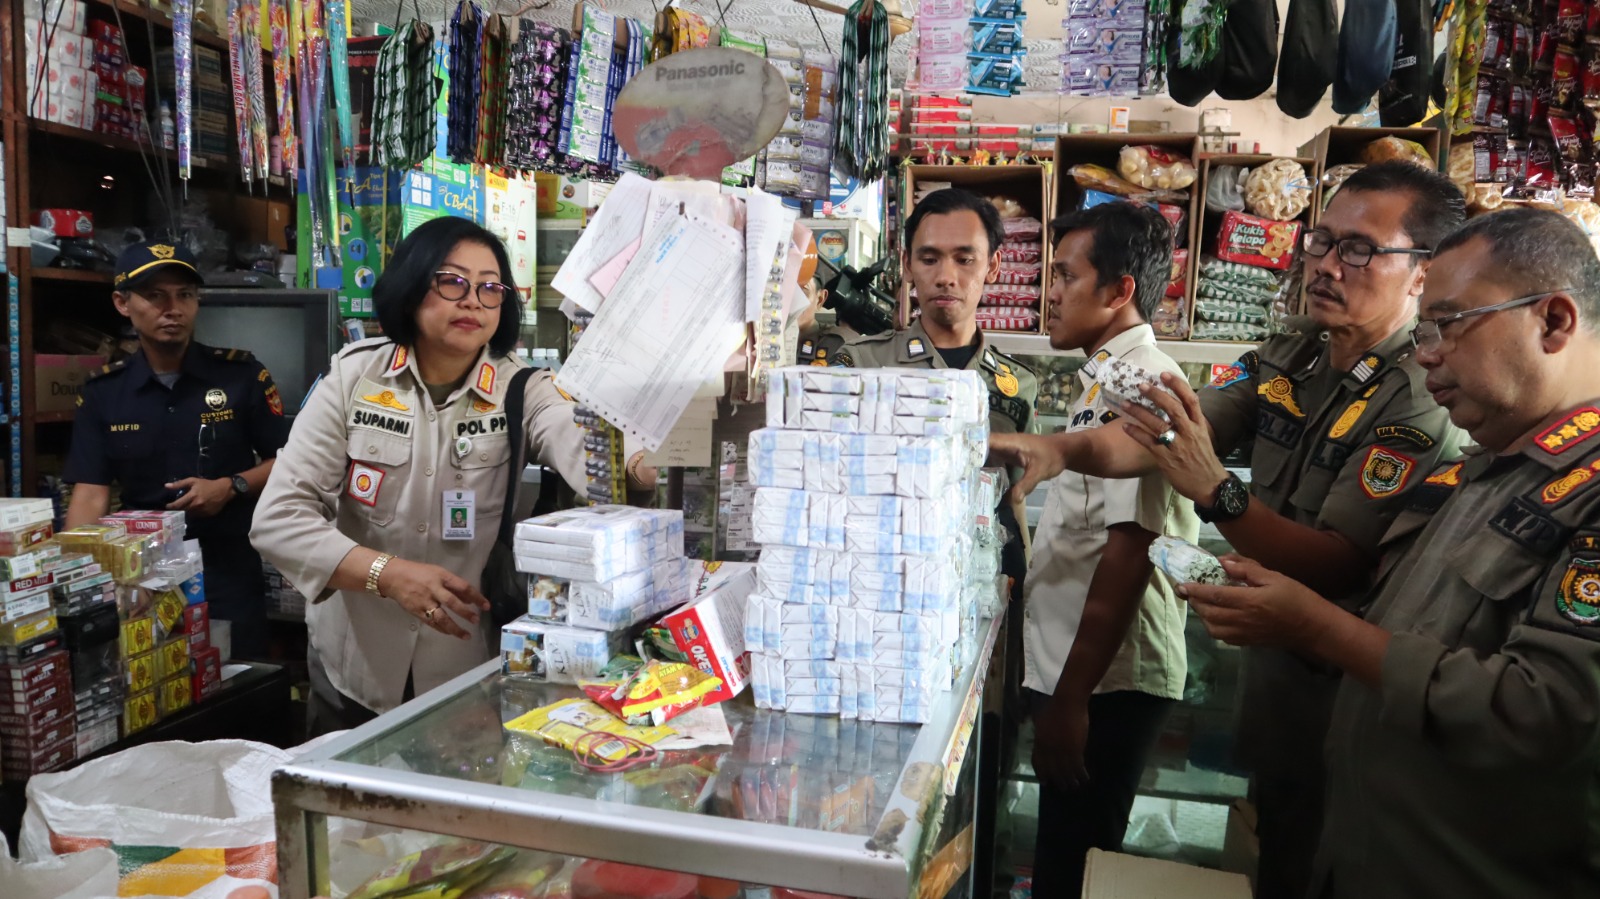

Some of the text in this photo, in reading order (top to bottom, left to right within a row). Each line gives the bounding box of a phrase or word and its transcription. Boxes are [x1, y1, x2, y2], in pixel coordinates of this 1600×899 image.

[655, 59, 745, 82] Panasonic
[1235, 223, 1266, 236] Kukis
[1228, 232, 1267, 246] Kelapa
[200, 408, 234, 419] CUSTOMS
[110, 423, 140, 432] MUFID
[353, 410, 410, 435] SUPARMI
[457, 416, 507, 437] POL PP
[135, 521, 158, 529] COUNTRY
[15, 579, 33, 591] RED
[658, 666, 677, 678] AYAM
